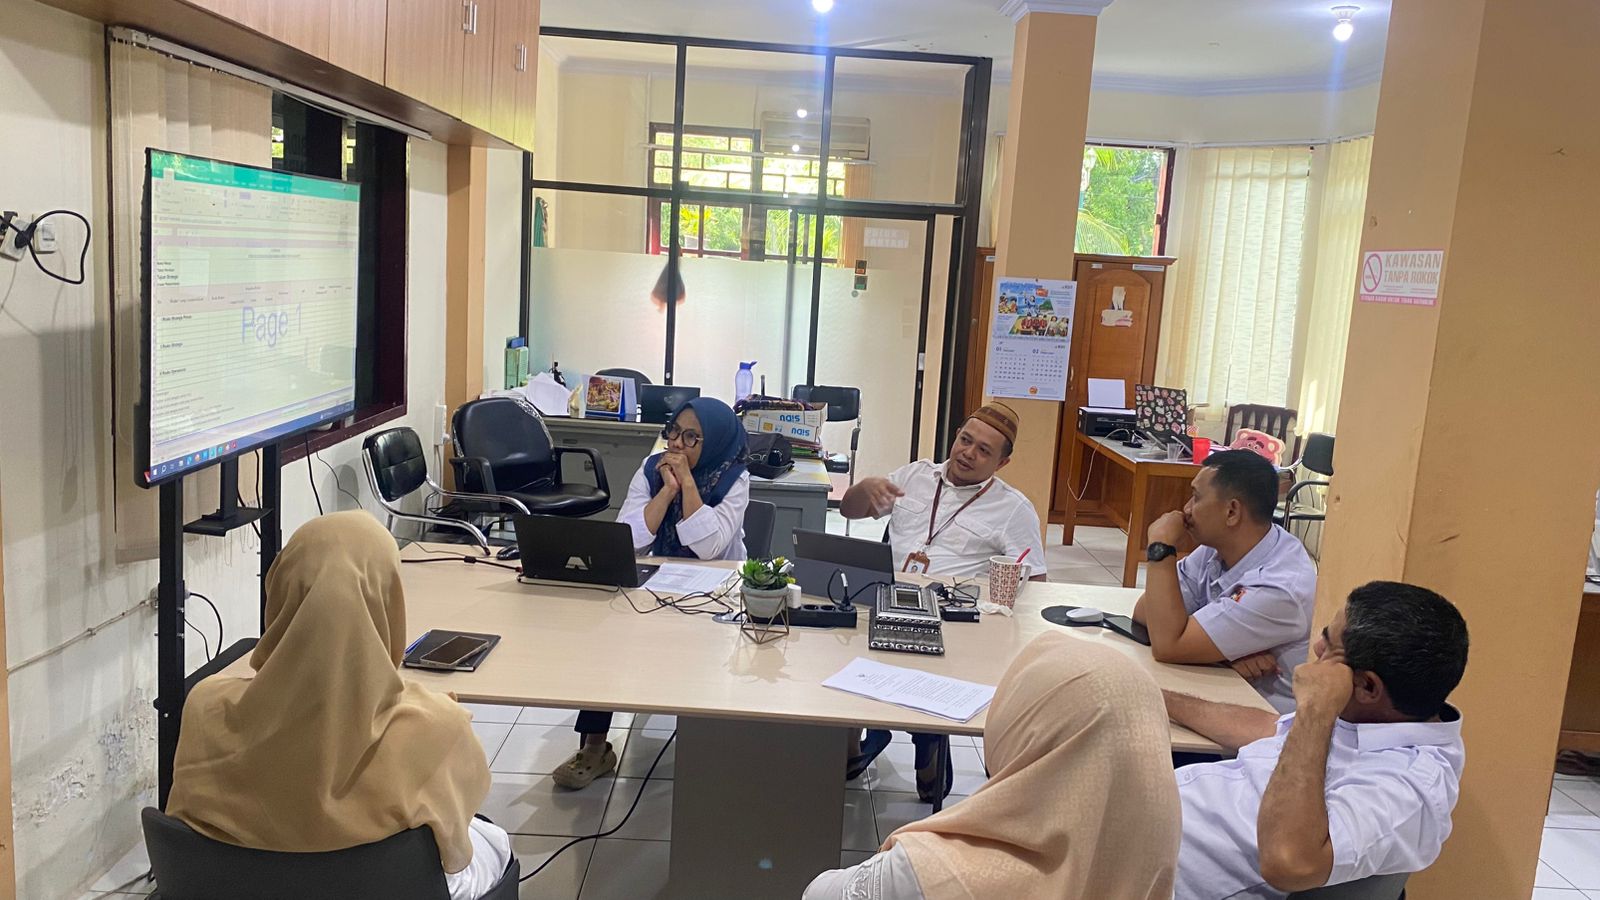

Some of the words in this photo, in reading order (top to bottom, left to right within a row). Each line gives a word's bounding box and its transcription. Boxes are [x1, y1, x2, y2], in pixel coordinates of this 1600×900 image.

[1385, 253, 1442, 269] KAWASAN
[1384, 270, 1409, 282] TANPA
[1410, 271, 1438, 284] ROKOK
[242, 306, 288, 348] Page
[295, 303, 302, 336] 1
